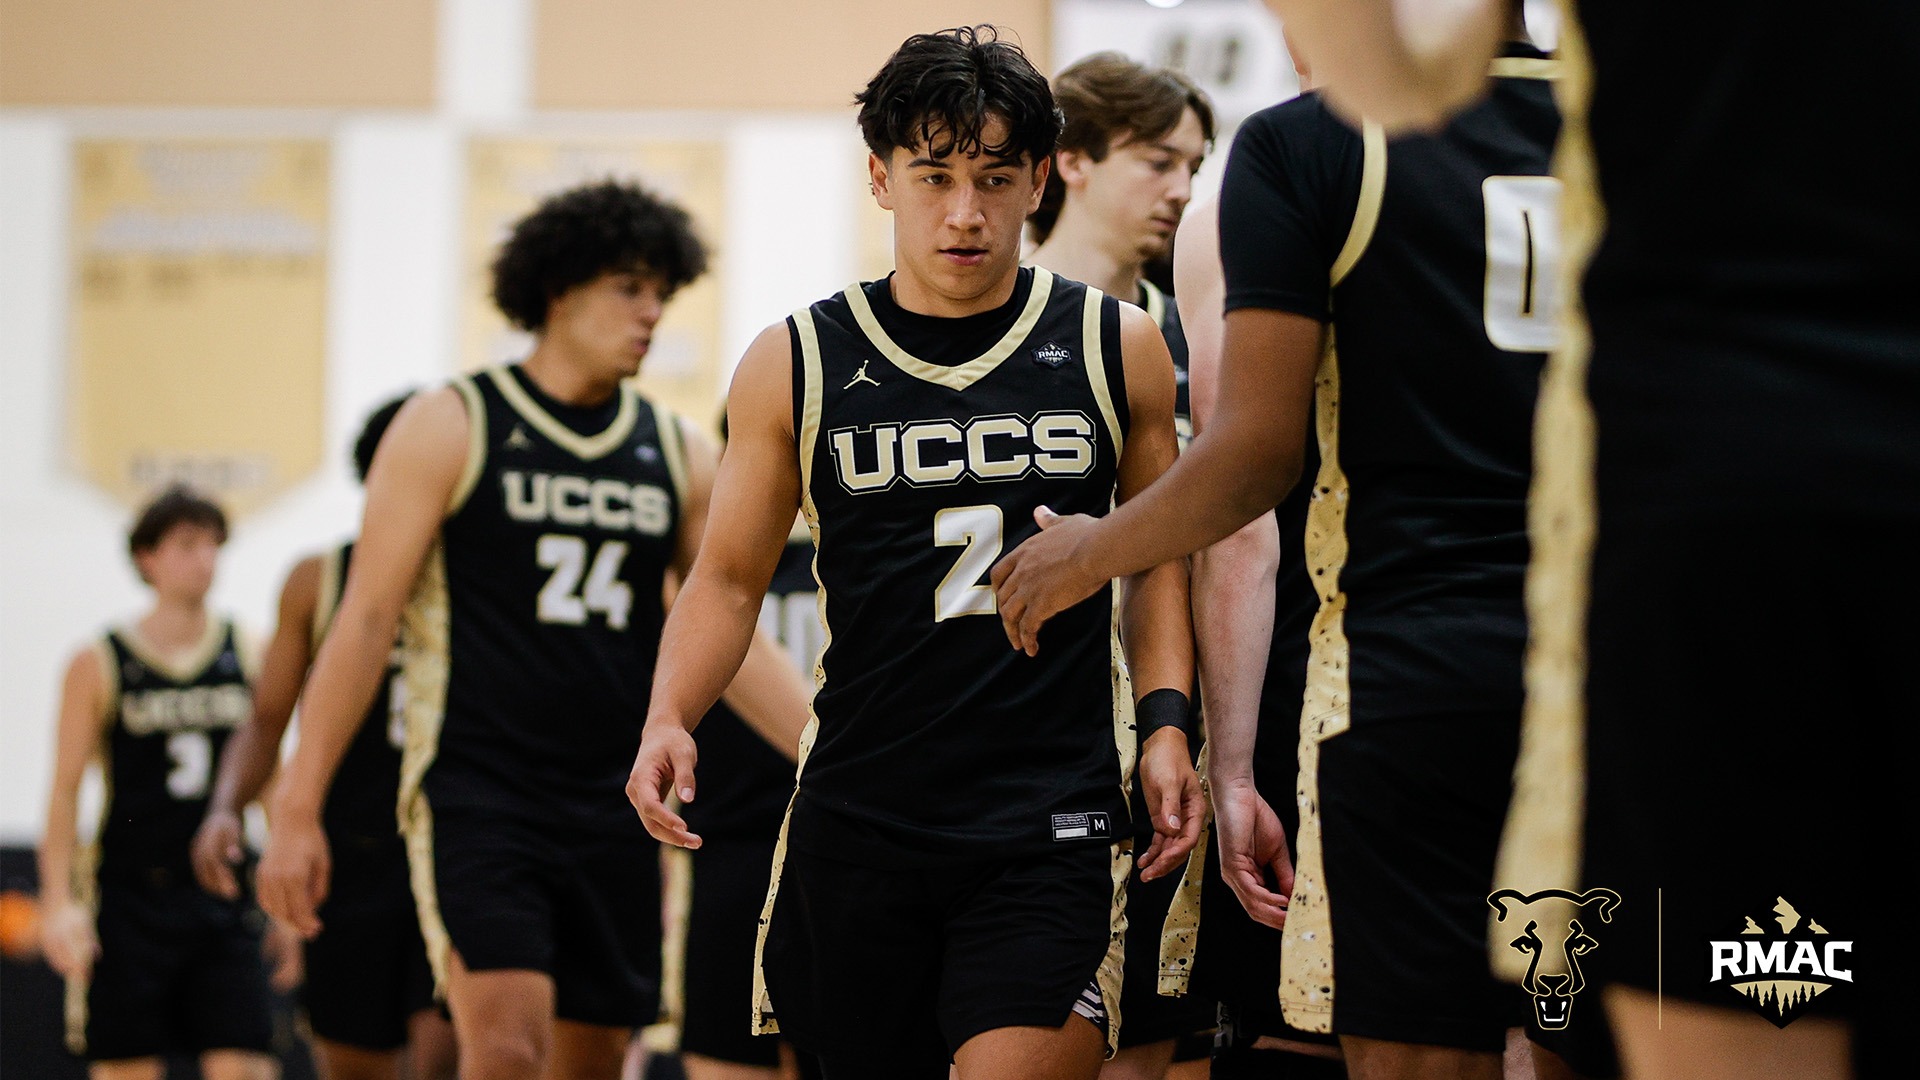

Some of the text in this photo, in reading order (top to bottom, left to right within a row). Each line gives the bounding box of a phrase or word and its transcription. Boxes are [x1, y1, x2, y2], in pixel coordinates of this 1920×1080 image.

[1038, 350, 1068, 359] RMAC
[830, 411, 1096, 494] UCCS
[502, 470, 672, 535] UCCS
[535, 533, 634, 631] 24
[934, 504, 1003, 622] 2
[165, 730, 213, 799] 3
[1094, 818, 1106, 831] M
